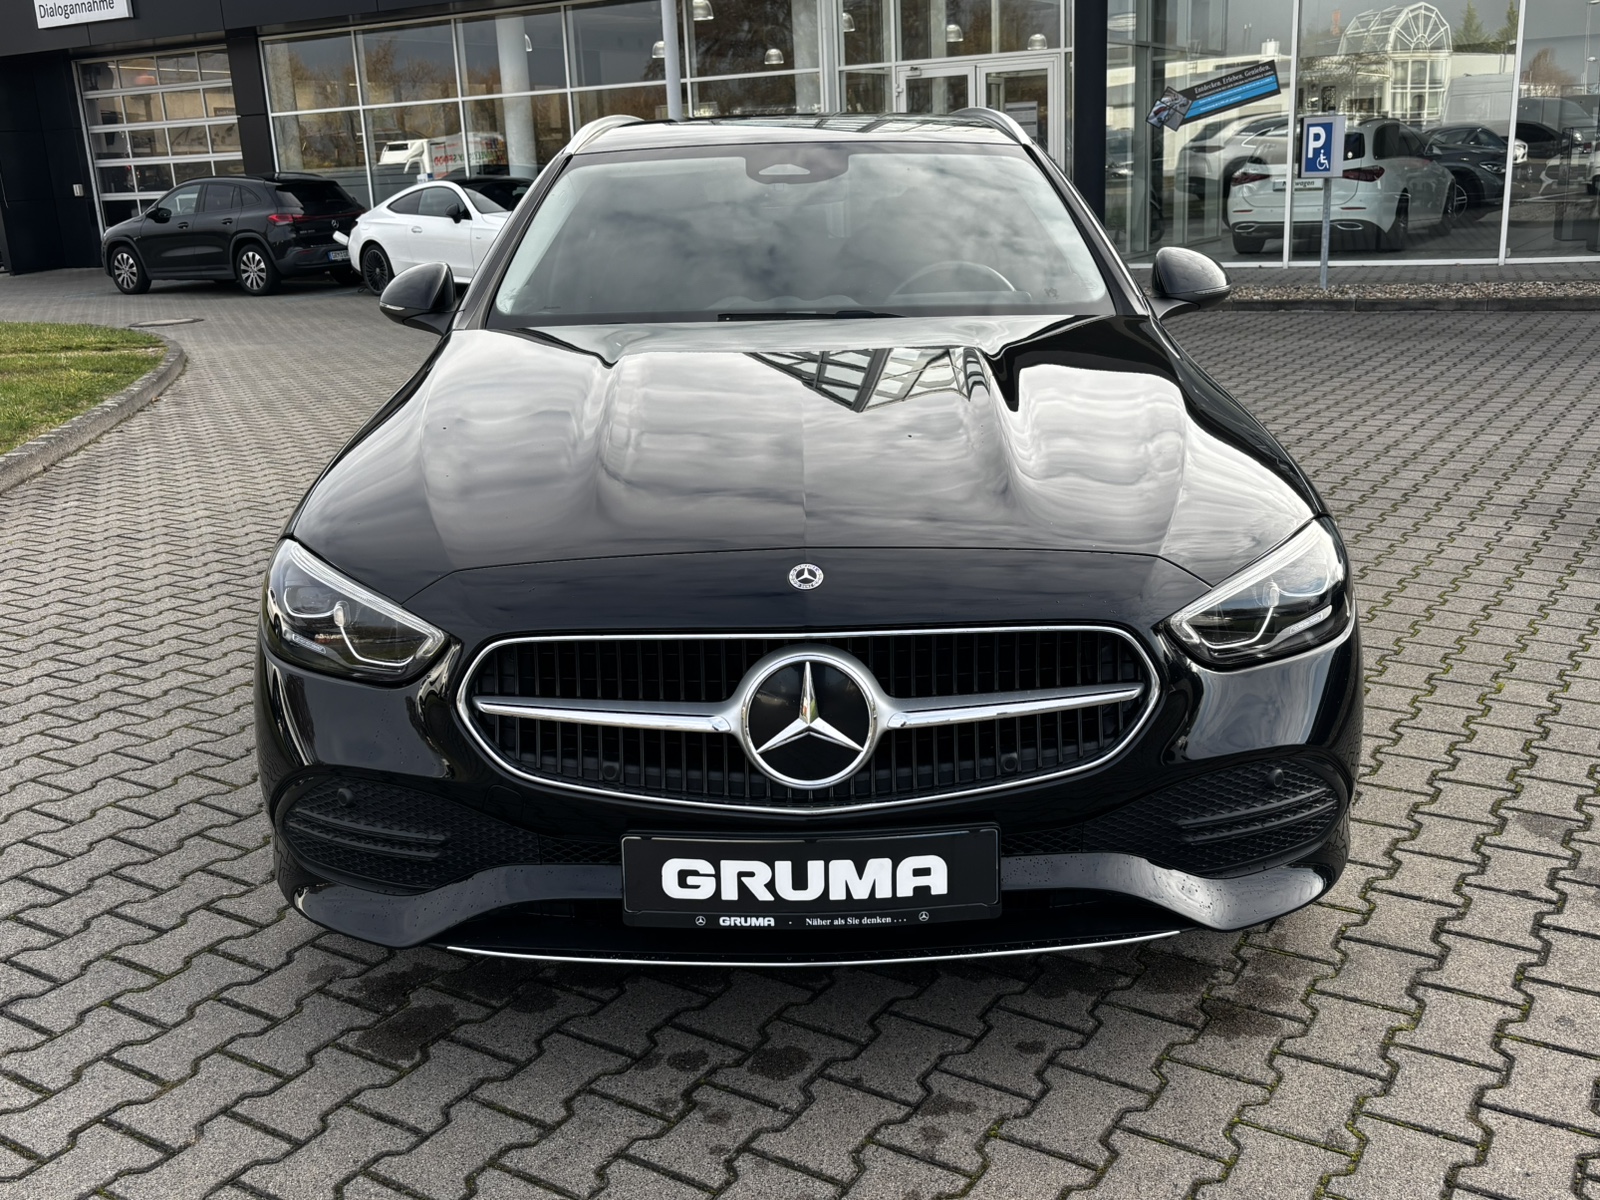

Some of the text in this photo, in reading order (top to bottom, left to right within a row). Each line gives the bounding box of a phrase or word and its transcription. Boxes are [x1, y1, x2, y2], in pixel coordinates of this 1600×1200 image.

[38, 0, 115, 19] Dialogannahme
[1307, 126, 1326, 158] P
[661, 854, 948, 901] GRUMA
[719, 916, 775, 927] GRUMA
[805, 917, 832, 926] Näher
[833, 917, 846, 925] als
[847, 916, 860, 925] Sie
[861, 916, 892, 924] denken
